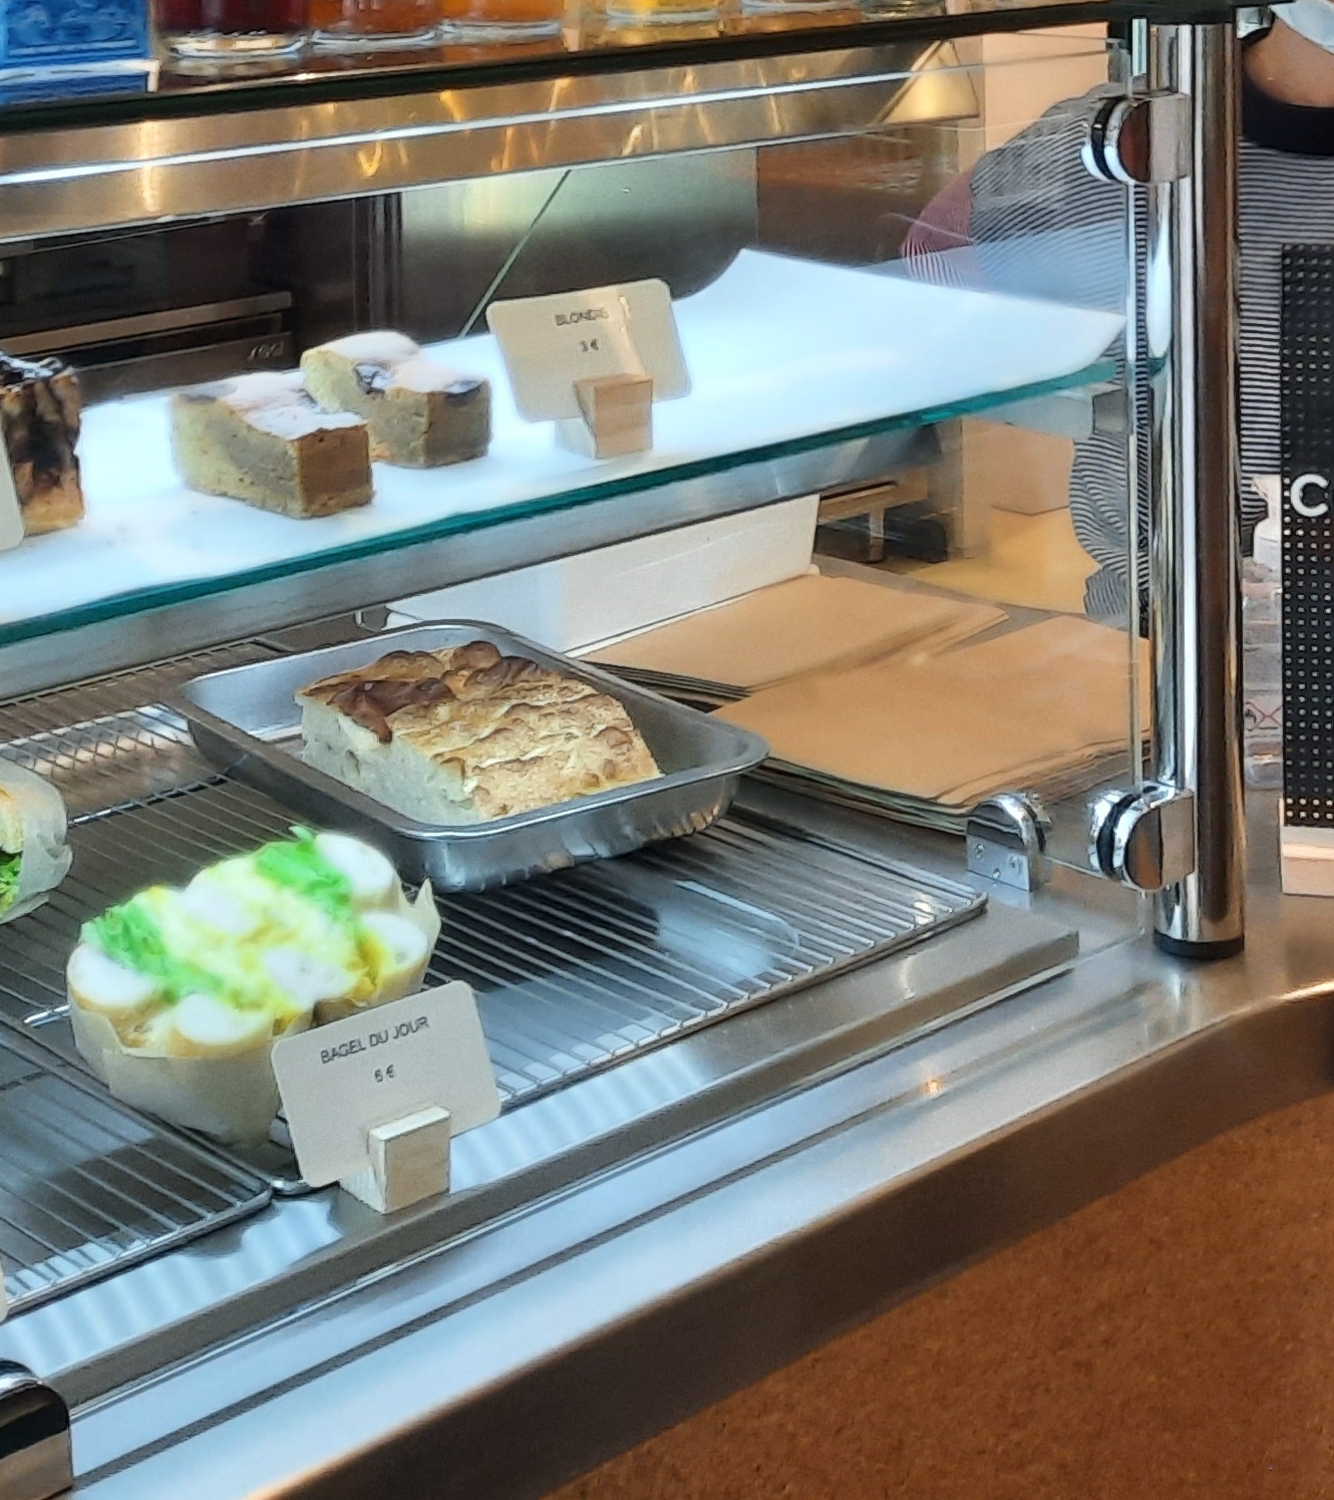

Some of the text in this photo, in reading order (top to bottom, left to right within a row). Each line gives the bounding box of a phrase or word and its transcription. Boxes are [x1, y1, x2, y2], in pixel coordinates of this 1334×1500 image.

[320, 1015, 430, 1065] BAGEL DU JOUR
